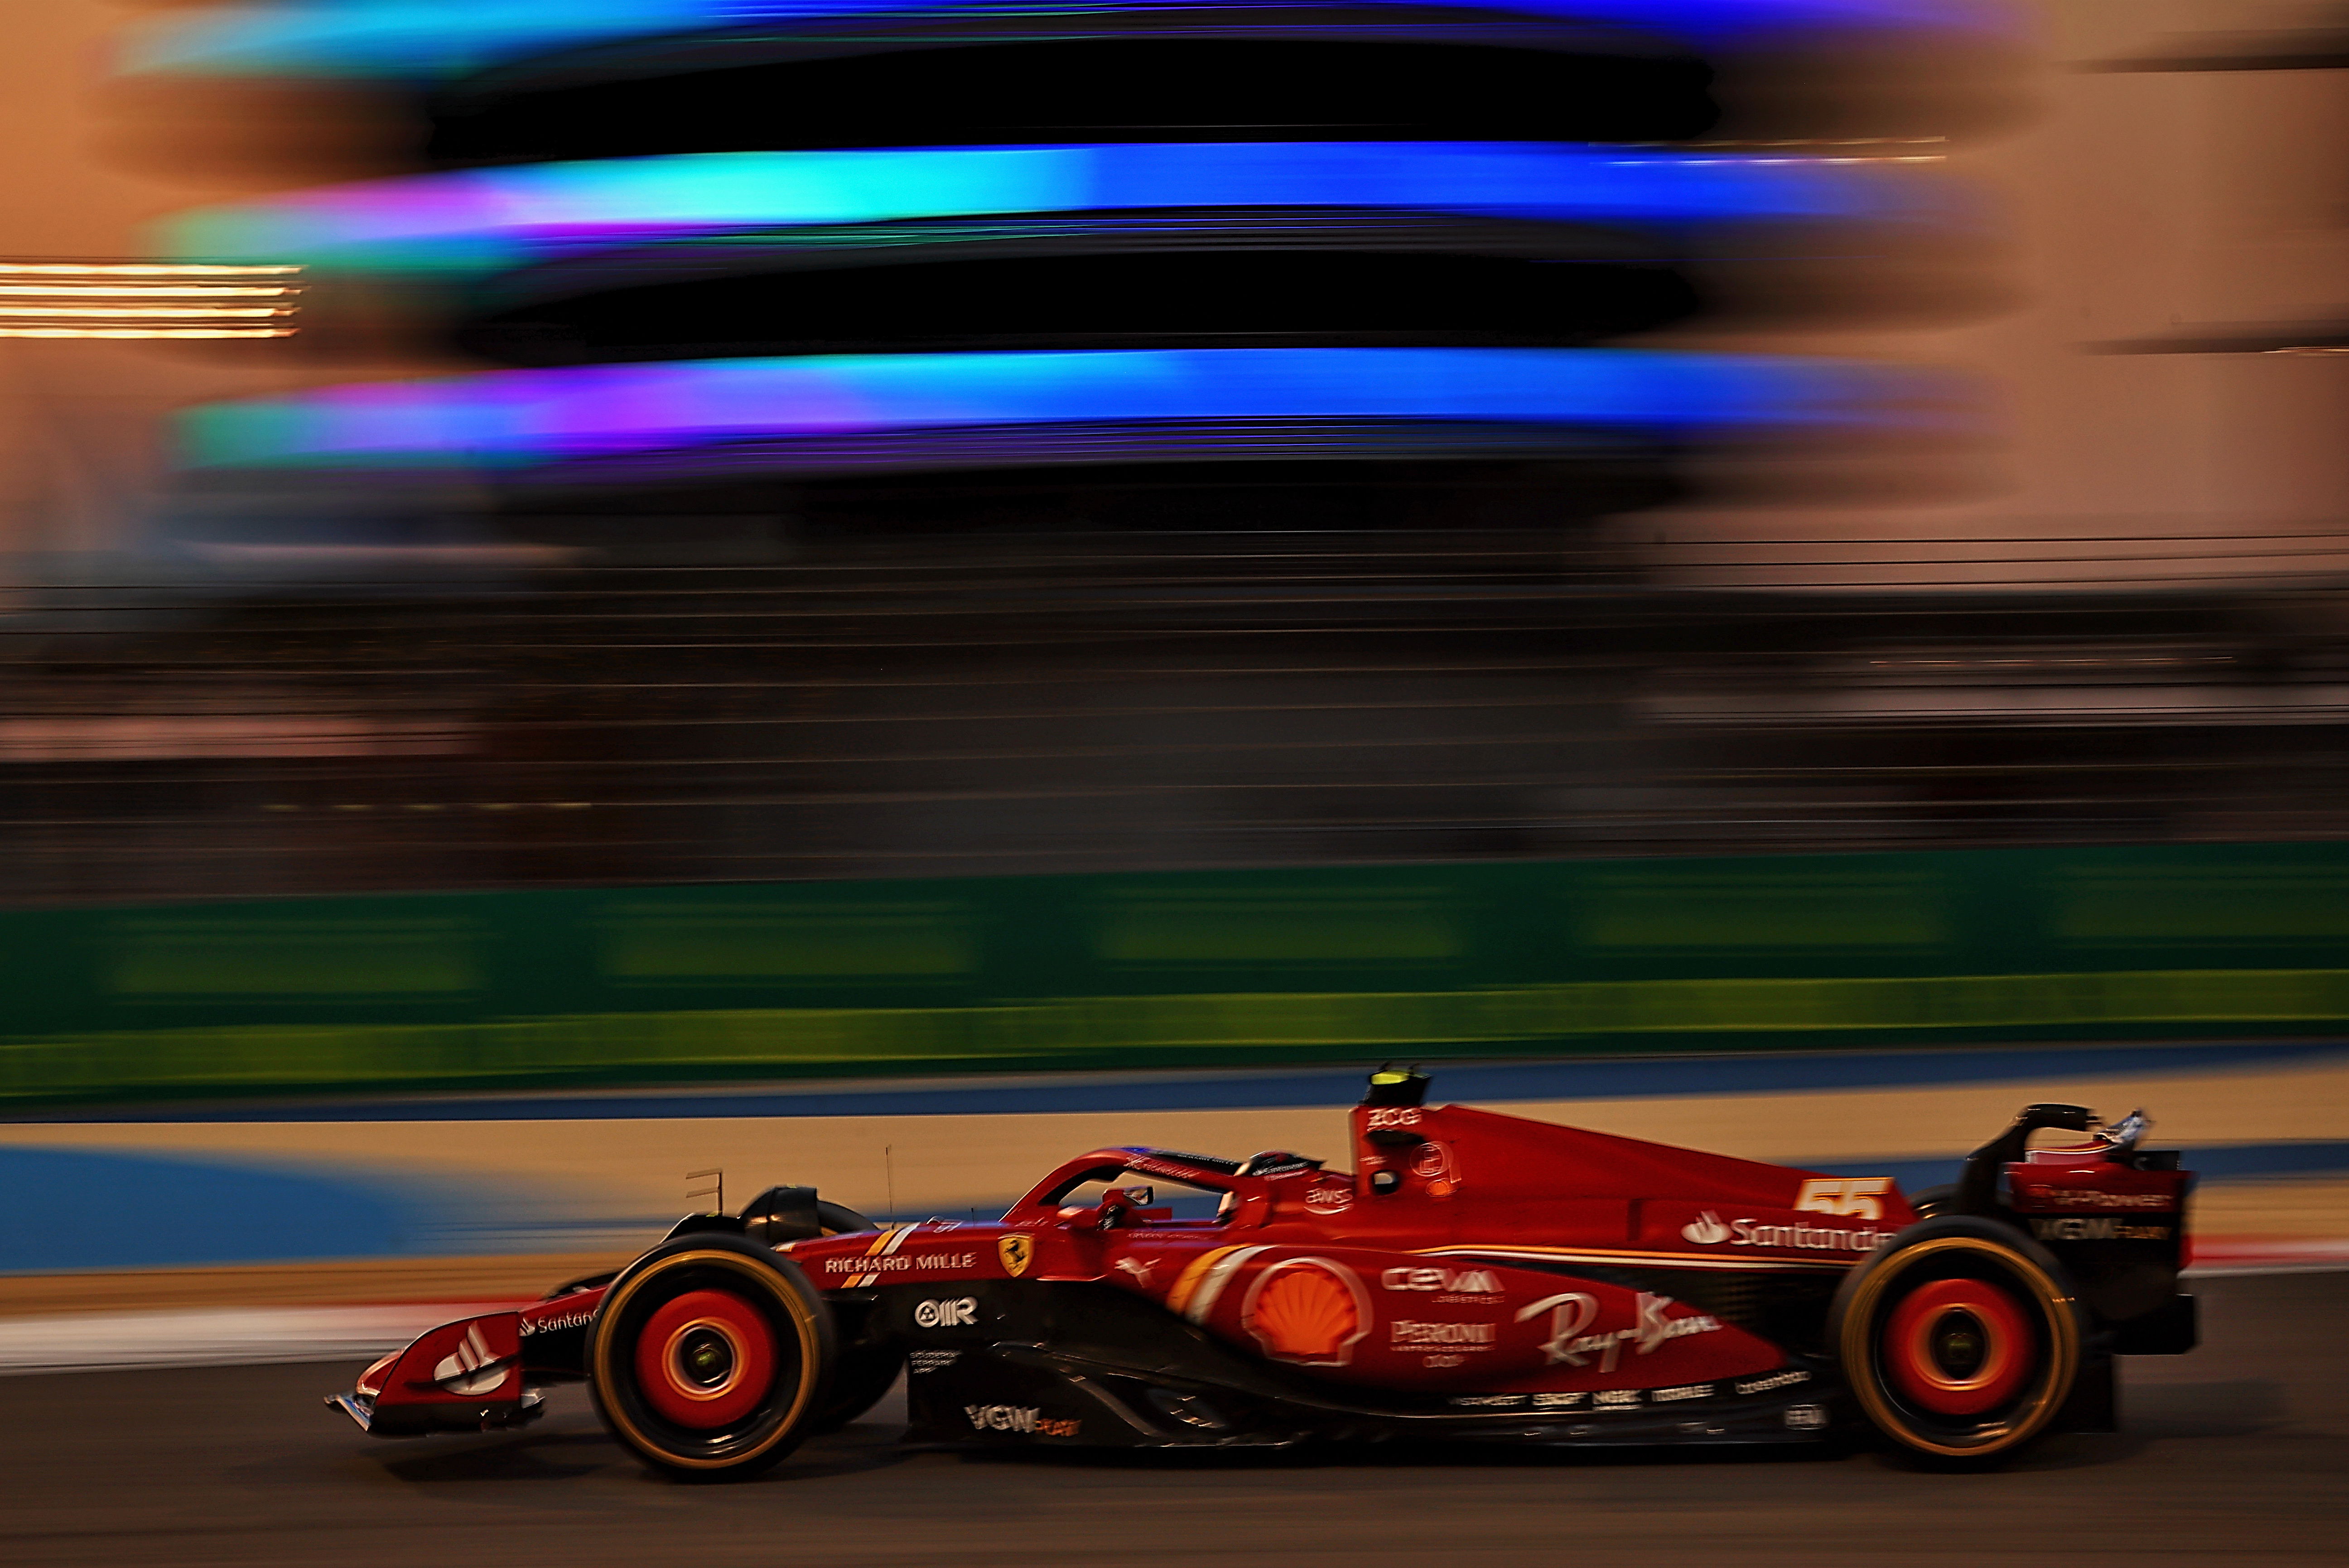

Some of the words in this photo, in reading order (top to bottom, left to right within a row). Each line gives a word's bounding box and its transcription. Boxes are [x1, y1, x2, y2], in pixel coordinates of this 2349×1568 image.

[1792, 1177, 1895, 1221] 55
[1728, 1218, 1897, 1251] Santande
[825, 1254, 913, 1273] RICHARD
[916, 1252, 978, 1269] MILLE
[538, 1309, 598, 1333] Santan
[963, 1404, 1041, 1433] VGW
